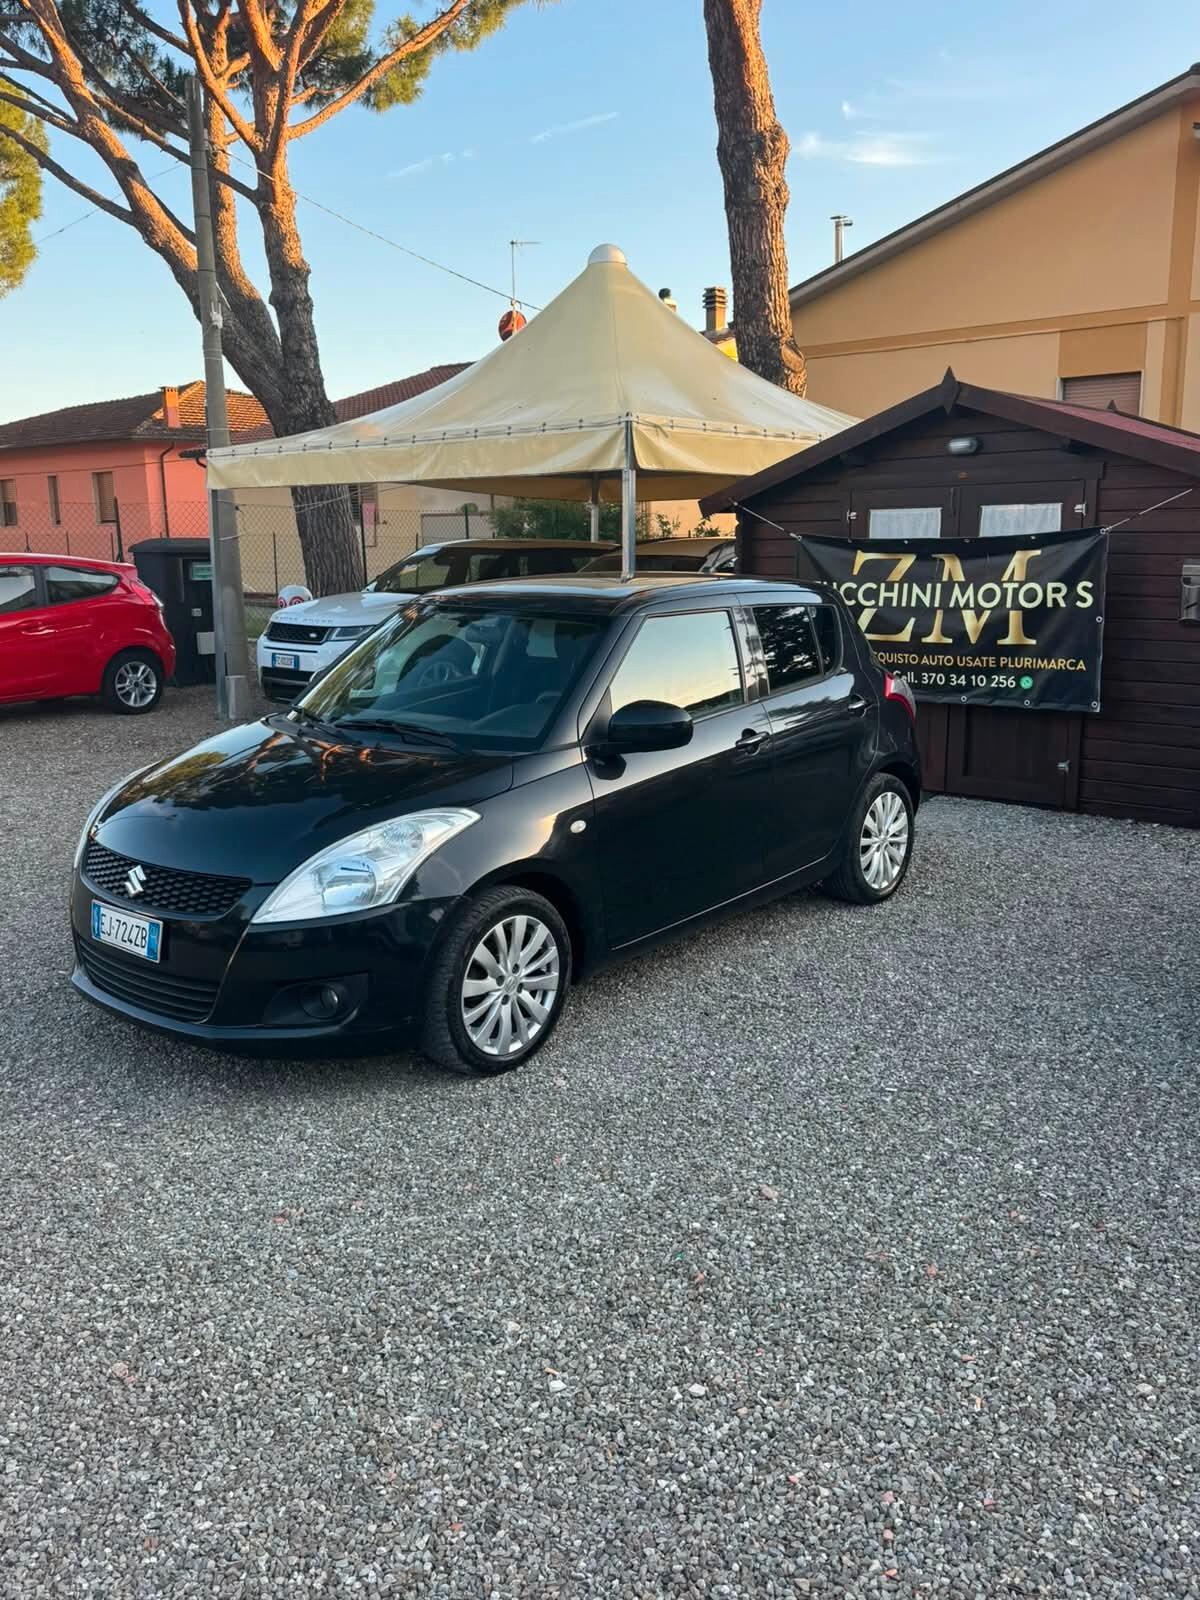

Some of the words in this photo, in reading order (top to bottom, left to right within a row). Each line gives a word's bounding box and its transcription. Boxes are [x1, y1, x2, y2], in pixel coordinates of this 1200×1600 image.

[815, 580, 942, 608] CCHINI
[921, 654, 954, 666] AUTO
[957, 656, 997, 668] USATE
[1000, 656, 1086, 671] PLURIMARCA
[921, 672, 945, 685] 370
[949, 674, 966, 686] 34
[970, 675, 986, 687] 10
[990, 675, 1016, 688] 256
